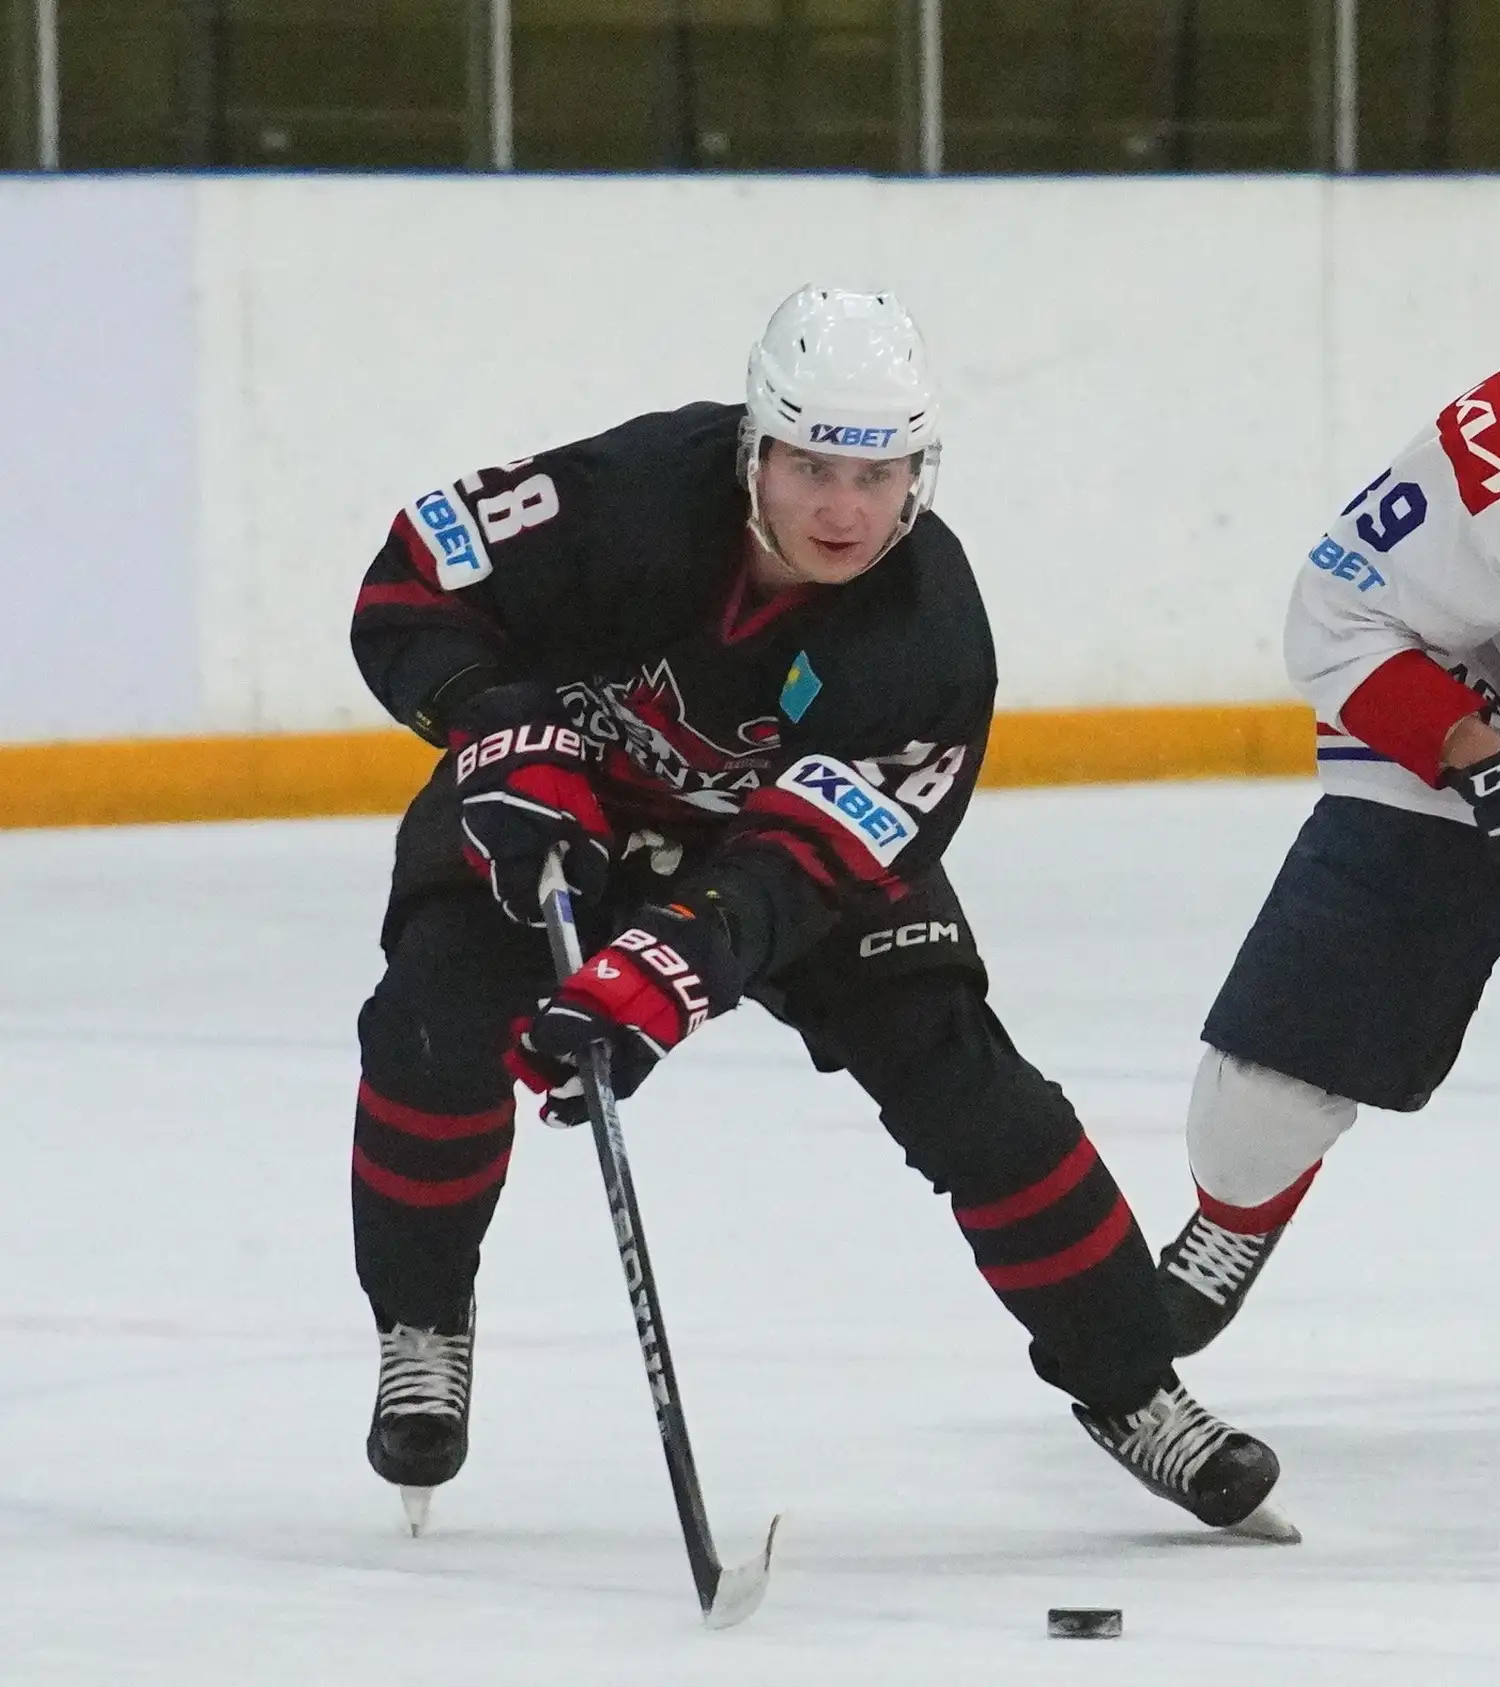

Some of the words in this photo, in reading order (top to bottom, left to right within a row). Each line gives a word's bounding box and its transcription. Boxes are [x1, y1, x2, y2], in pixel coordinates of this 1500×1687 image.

[810, 424, 898, 448] 1XBET
[416, 490, 480, 569] BET
[461, 456, 560, 544] 8
[1340, 467, 1428, 553] 9
[1308, 533, 1386, 592] BET
[793, 762, 909, 848] 1XBET
[860, 921, 959, 958] CCM
